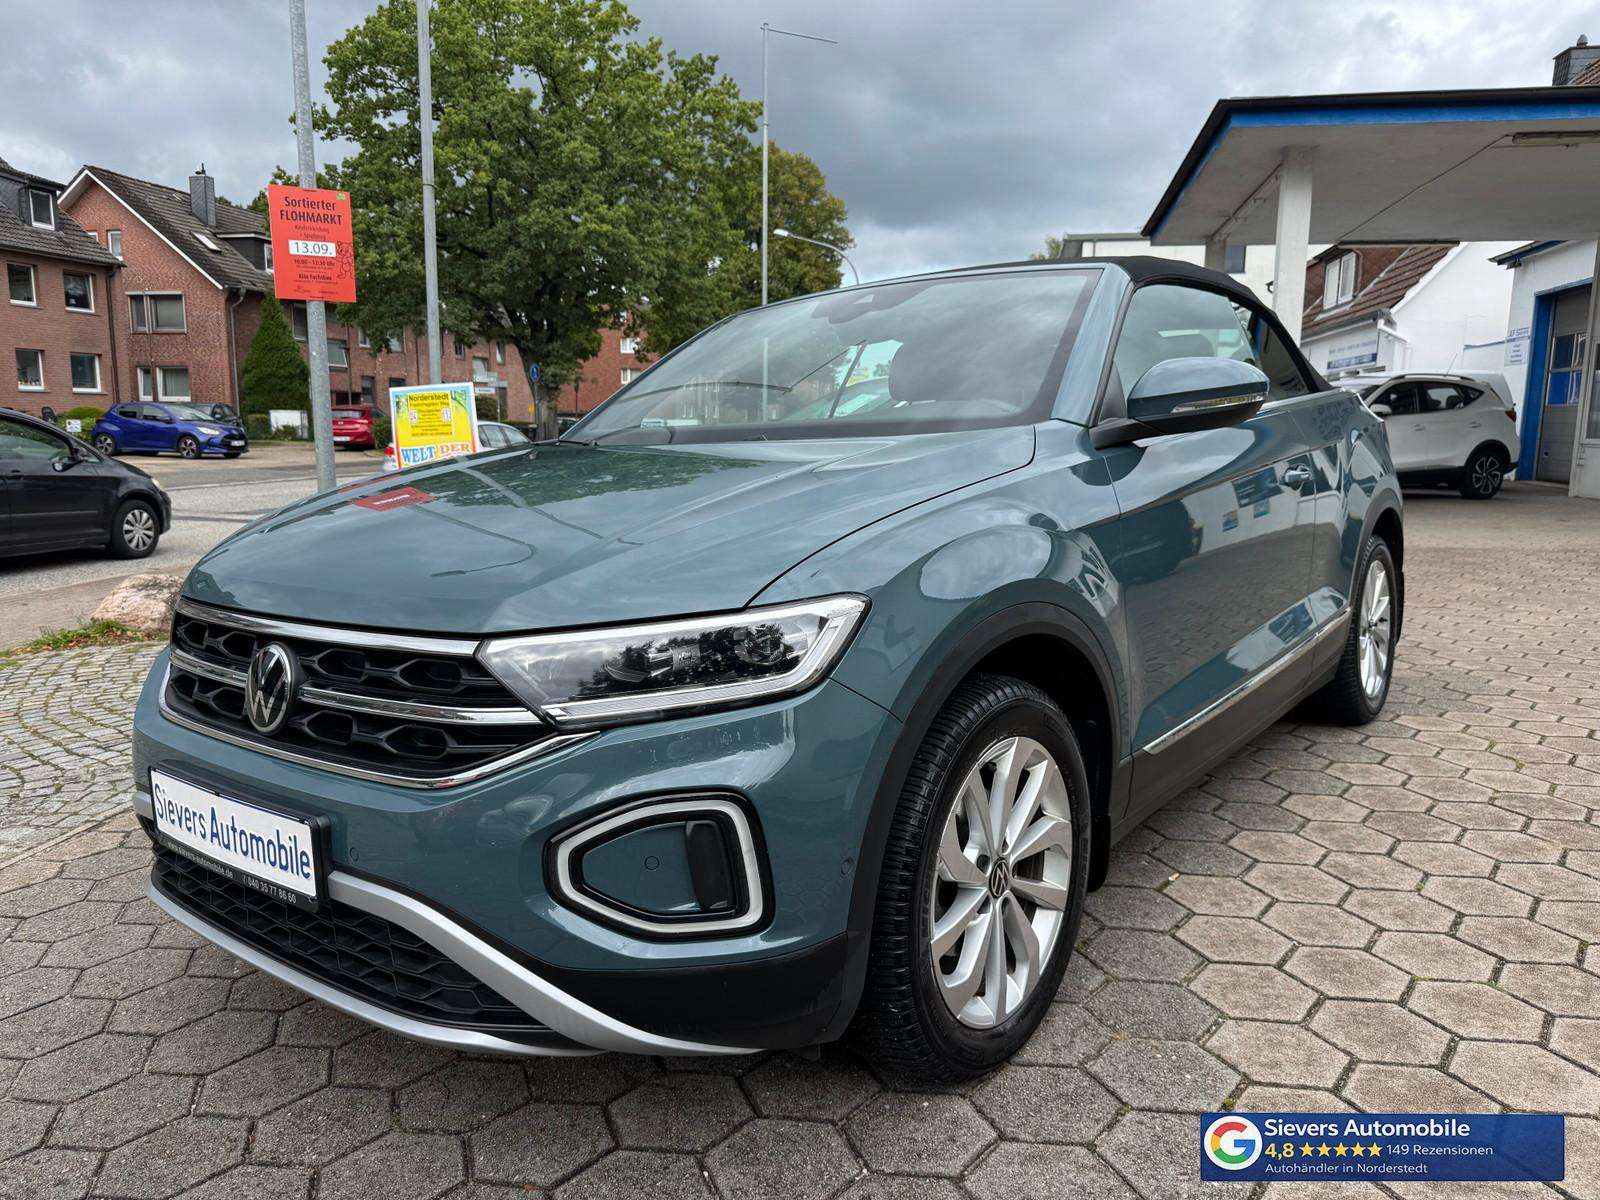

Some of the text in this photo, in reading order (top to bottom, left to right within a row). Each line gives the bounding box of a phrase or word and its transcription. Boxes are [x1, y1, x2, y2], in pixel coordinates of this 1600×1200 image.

[284, 196, 337, 211] Sortierter
[280, 210, 343, 225] FLOHMARKT
[294, 242, 333, 255] 13.09.
[409, 393, 449, 401] Norderstedt
[401, 447, 435, 464] WELT
[440, 443, 470, 453] DER
[154, 783, 311, 879] Sievers Automobile
